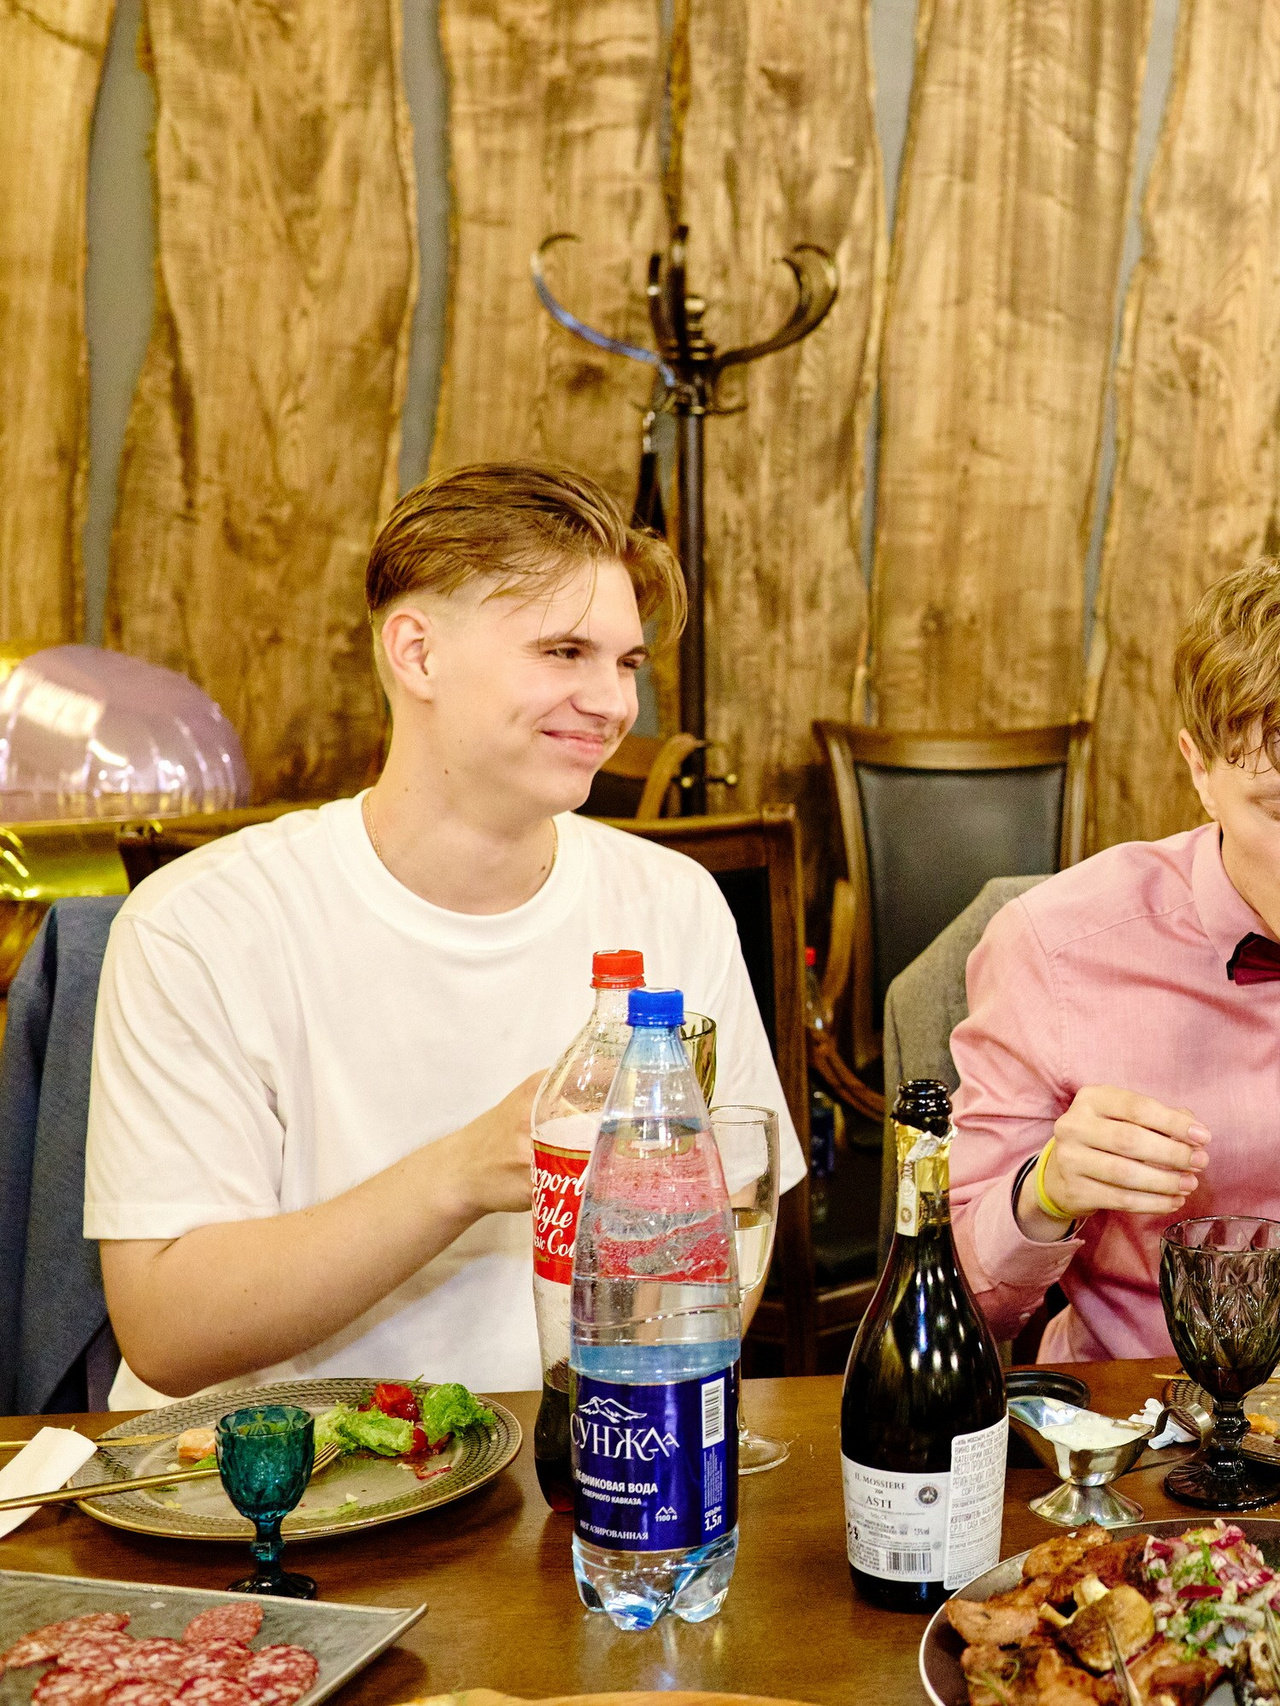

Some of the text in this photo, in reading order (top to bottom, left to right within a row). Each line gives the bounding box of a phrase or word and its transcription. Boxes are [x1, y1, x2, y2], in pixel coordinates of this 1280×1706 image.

[530, 1160, 588, 1197] xport
[627, 1482, 658, 1495] ВОДА
[863, 1476, 906, 1490] MOSSIERE
[611, 1495, 642, 1505] КАВКАЗА
[865, 1495, 892, 1509] ASTI
